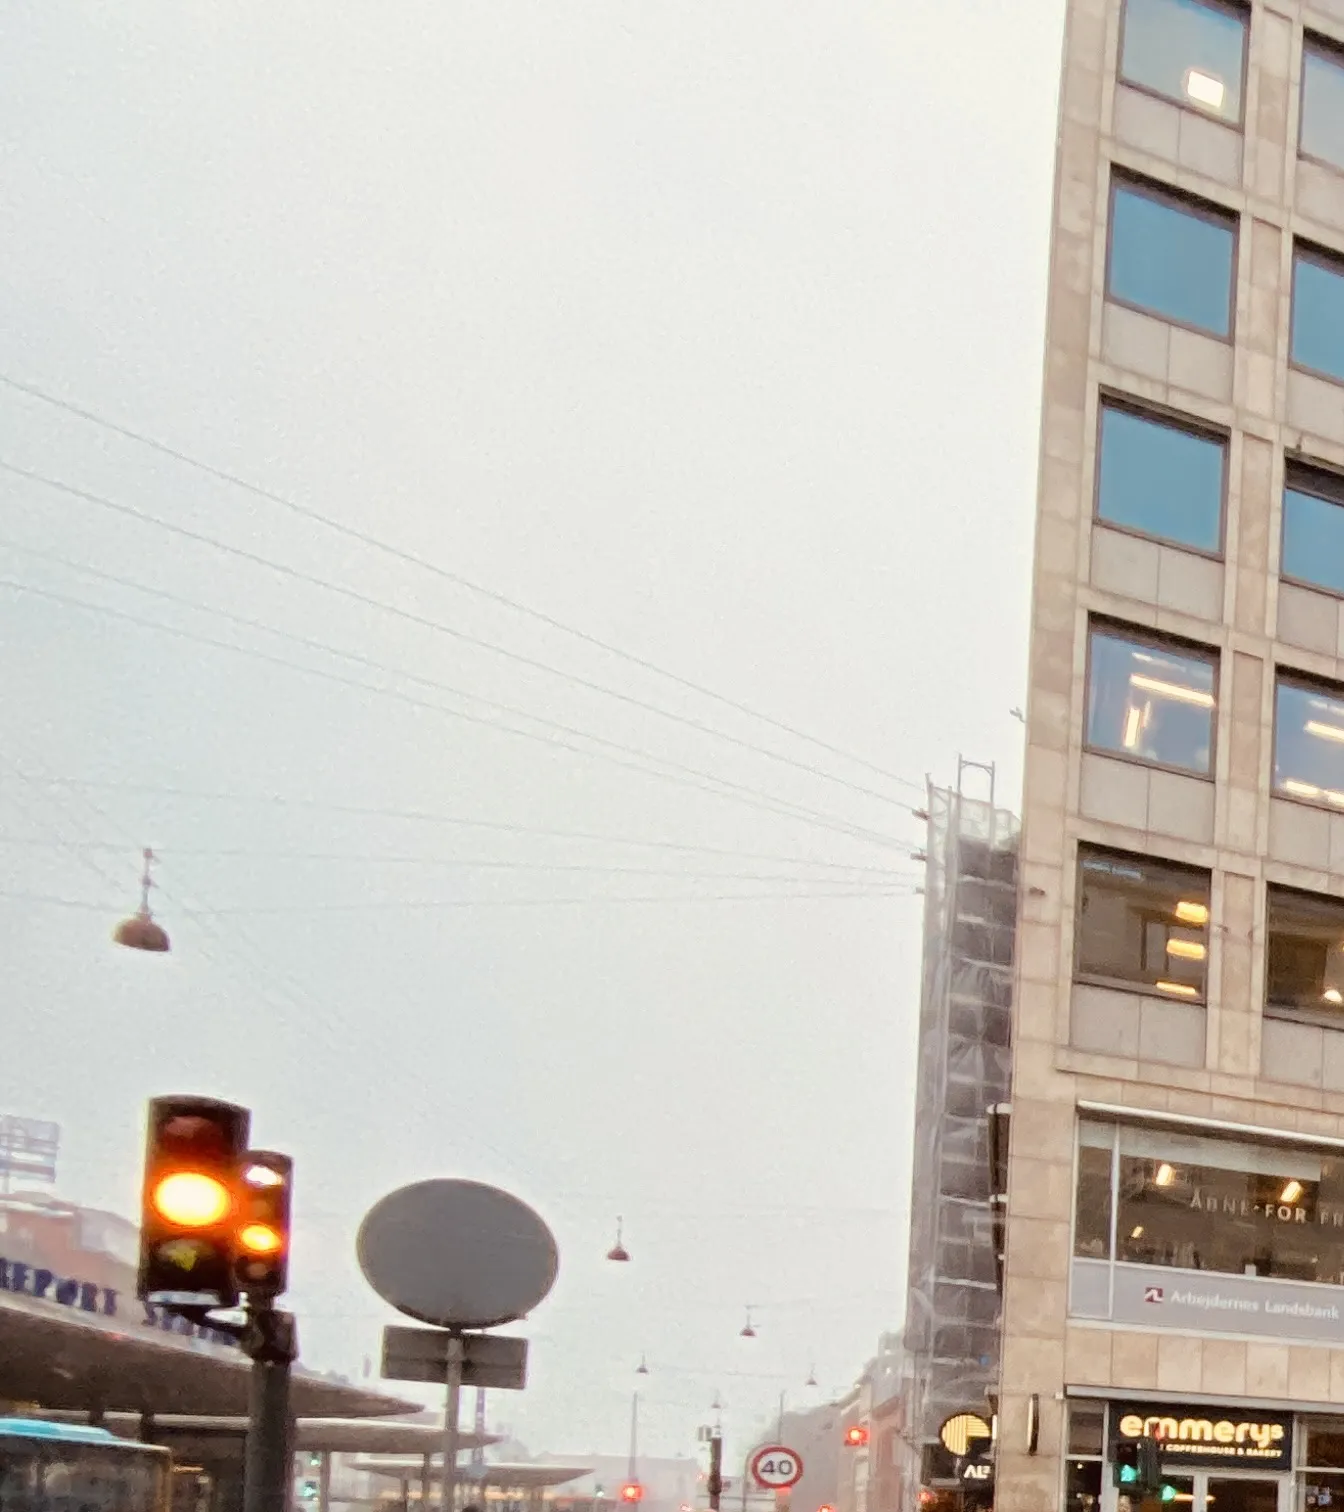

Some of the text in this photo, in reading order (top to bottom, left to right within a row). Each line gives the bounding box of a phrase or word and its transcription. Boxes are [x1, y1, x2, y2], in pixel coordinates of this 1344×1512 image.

[1264, 1205, 1308, 1223] FOR
[1171, 1290, 1259, 1313] Arbejdernes
[1265, 1300, 1340, 1322] Landsbank
[1120, 1415, 1284, 1449] emmerys
[761, 1460, 793, 1476] 40
